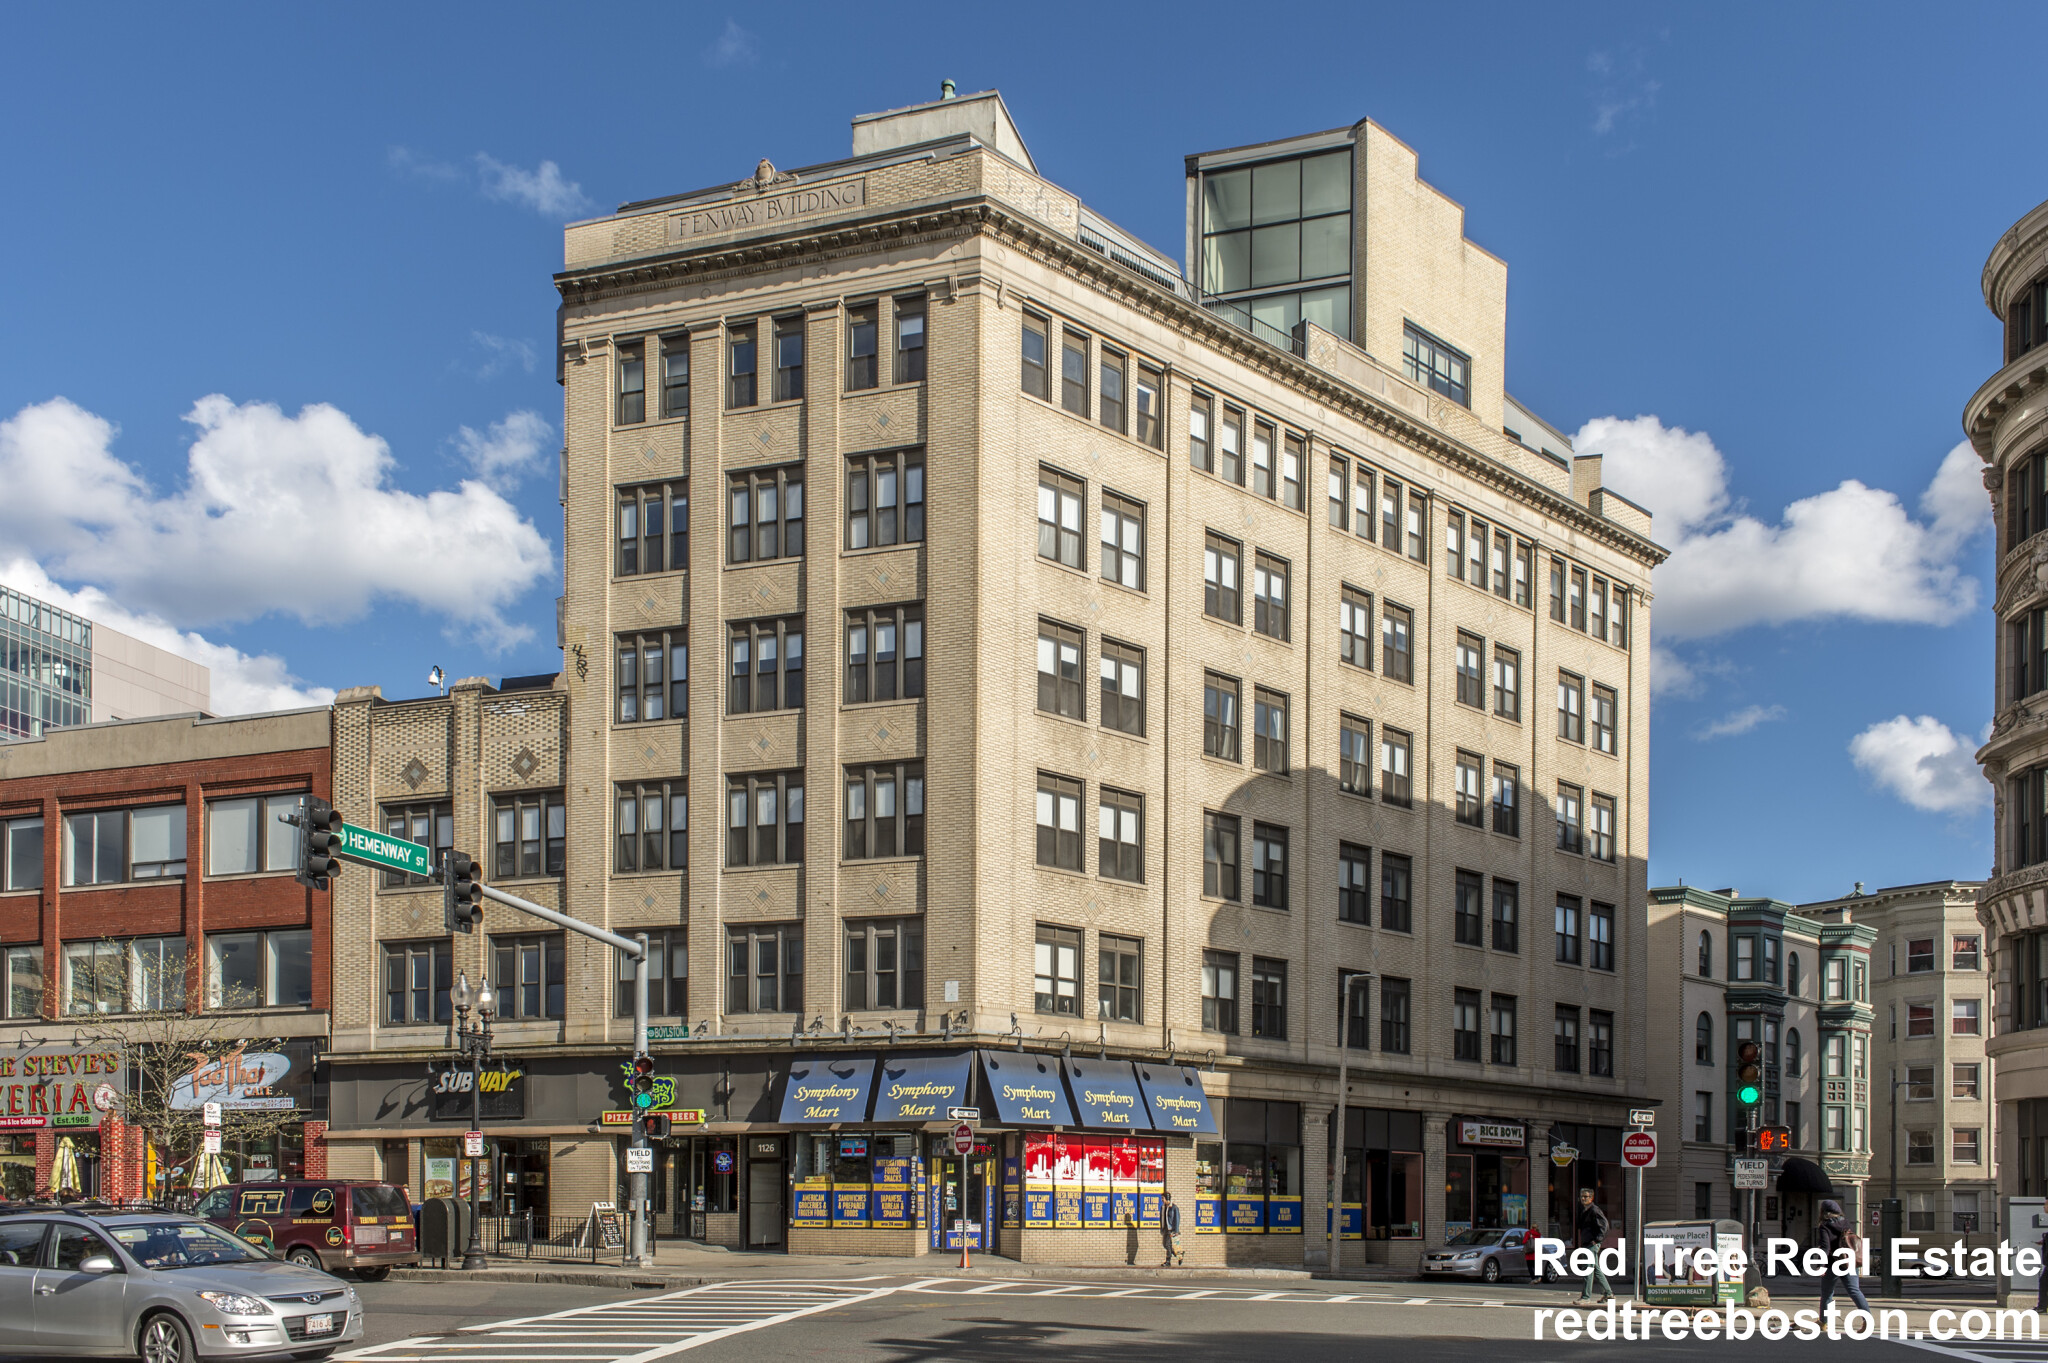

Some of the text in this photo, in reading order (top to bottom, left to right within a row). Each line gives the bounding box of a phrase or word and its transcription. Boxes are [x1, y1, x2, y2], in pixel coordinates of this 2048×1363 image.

[679, 203, 759, 236] FENWAY
[349, 832, 424, 867] HEMENWAY ST
[654, 1026, 684, 1038] BOYLSTON
[25, 1052, 119, 1076] STEVE'S
[793, 1084, 859, 1102] Symphony
[887, 1082, 955, 1100] Symphony
[1003, 1085, 1056, 1103] Symphony
[0, 1083, 91, 1115] ERIA
[1084, 1090, 1134, 1108] Symphony
[1155, 1095, 1202, 1113] Symphony
[804, 1106, 840, 1118] Mart
[899, 1104, 936, 1116] Mart
[1021, 1106, 1051, 1120] Mart
[671, 1112, 695, 1121] BEER
[1102, 1111, 1130, 1123] Mart
[1172, 1115, 1198, 1128] Mart
[1480, 1125, 1499, 1137] RICE
[1500, 1127, 1523, 1139] BOWL
[531, 1141, 549, 1151] 1122
[662, 1138, 680, 1148] 1124
[1780, 1133, 1788, 1148] 5
[758, 1144, 775, 1153] 1126
[876, 1159, 910, 1167] INTERNATIONAL
[1738, 1161, 1765, 1170] YIELD
[1008, 1167, 1017, 1177] ATM
[883, 1174, 902, 1183] SNACKS
[838, 1194, 867, 1202] SANDWICHES
[798, 1201, 822, 1209] GROCERIES
[842, 1202, 866, 1210] PREPARED
[881, 1202, 900, 1210] KOREAN
[798, 1209, 828, 1217] FROZEN FOODS
[843, 1209, 859, 1217] FOODS
[882, 1209, 903, 1218] SPANISH
[1687, 1231, 1709, 1239] Place?
[949, 1237, 979, 1247] WELOME
